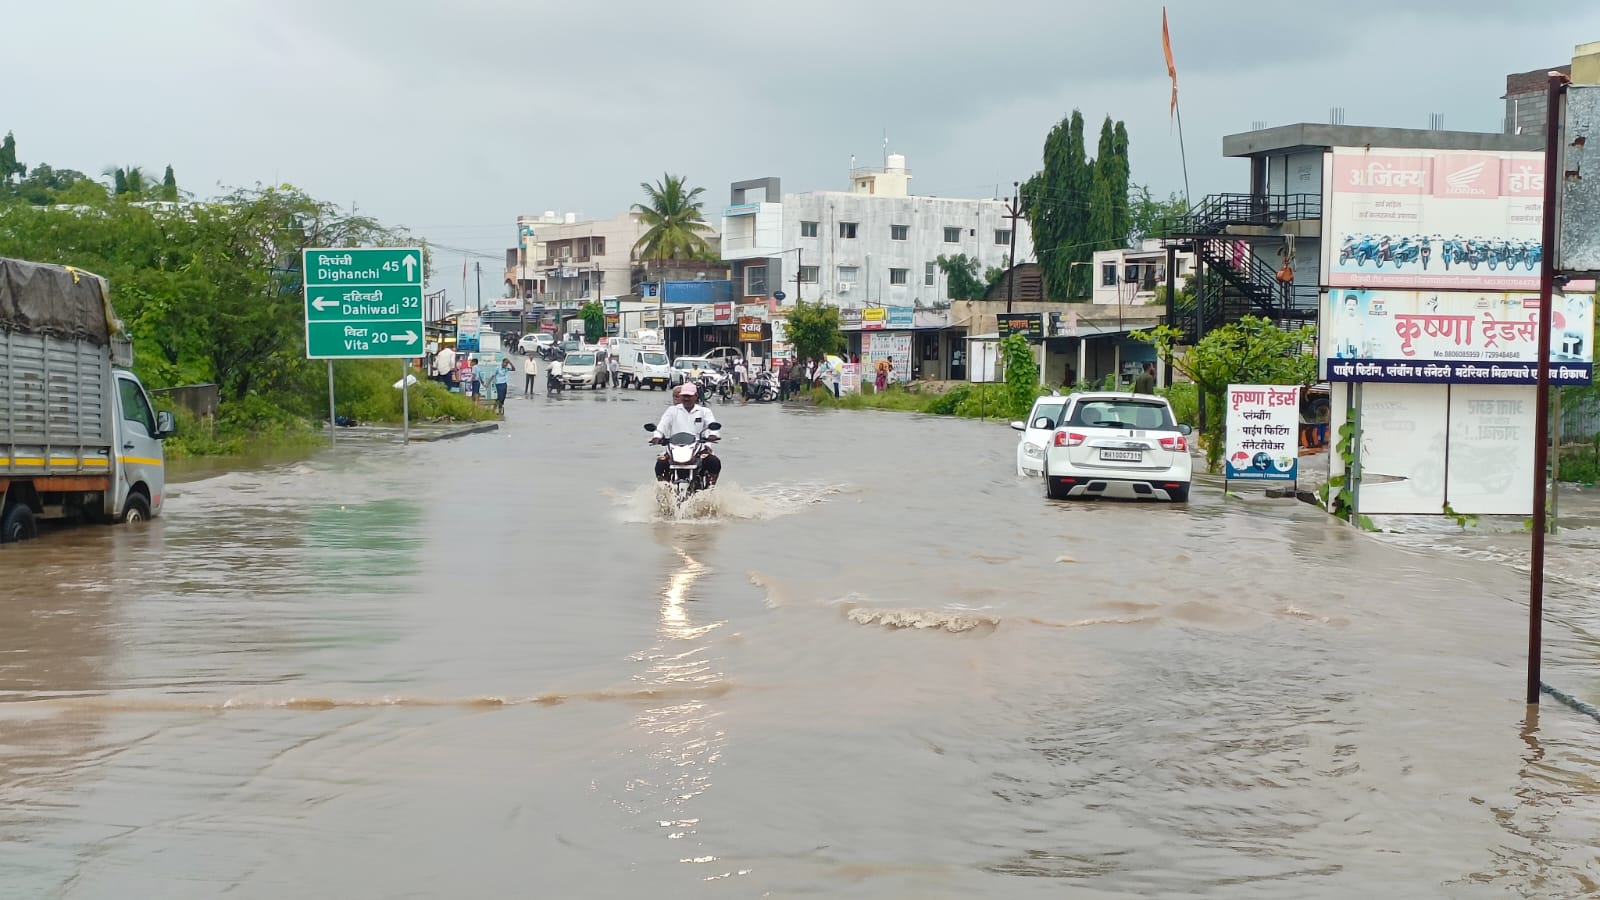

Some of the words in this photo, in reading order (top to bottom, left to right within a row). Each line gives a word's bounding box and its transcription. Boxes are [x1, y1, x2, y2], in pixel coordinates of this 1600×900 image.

[1350, 161, 1426, 188] अजिंक्य
[1507, 165, 1544, 193] होंड
[318, 268, 379, 281] Dighanchi
[382, 261, 399, 272] 45
[342, 304, 399, 315] Dahiwadi
[402, 297, 418, 308] 32
[344, 325, 368, 337] विटा
[1394, 313, 1475, 357] कृष्णा
[1482, 312, 1538, 348] ट्रेडर्स
[344, 339, 369, 350] Vita
[371, 332, 388, 343] 20
[1333, 362, 1354, 377] पाईप
[1415, 366, 1422, 376] व
[1455, 365, 1490, 378] मटेरियल
[1491, 365, 1529, 379] मिळण्याचे
[1231, 391, 1266, 410] कृष्णा
[1268, 388, 1297, 407] ट्रेडर्स
[1242, 424, 1262, 437] पाईप
